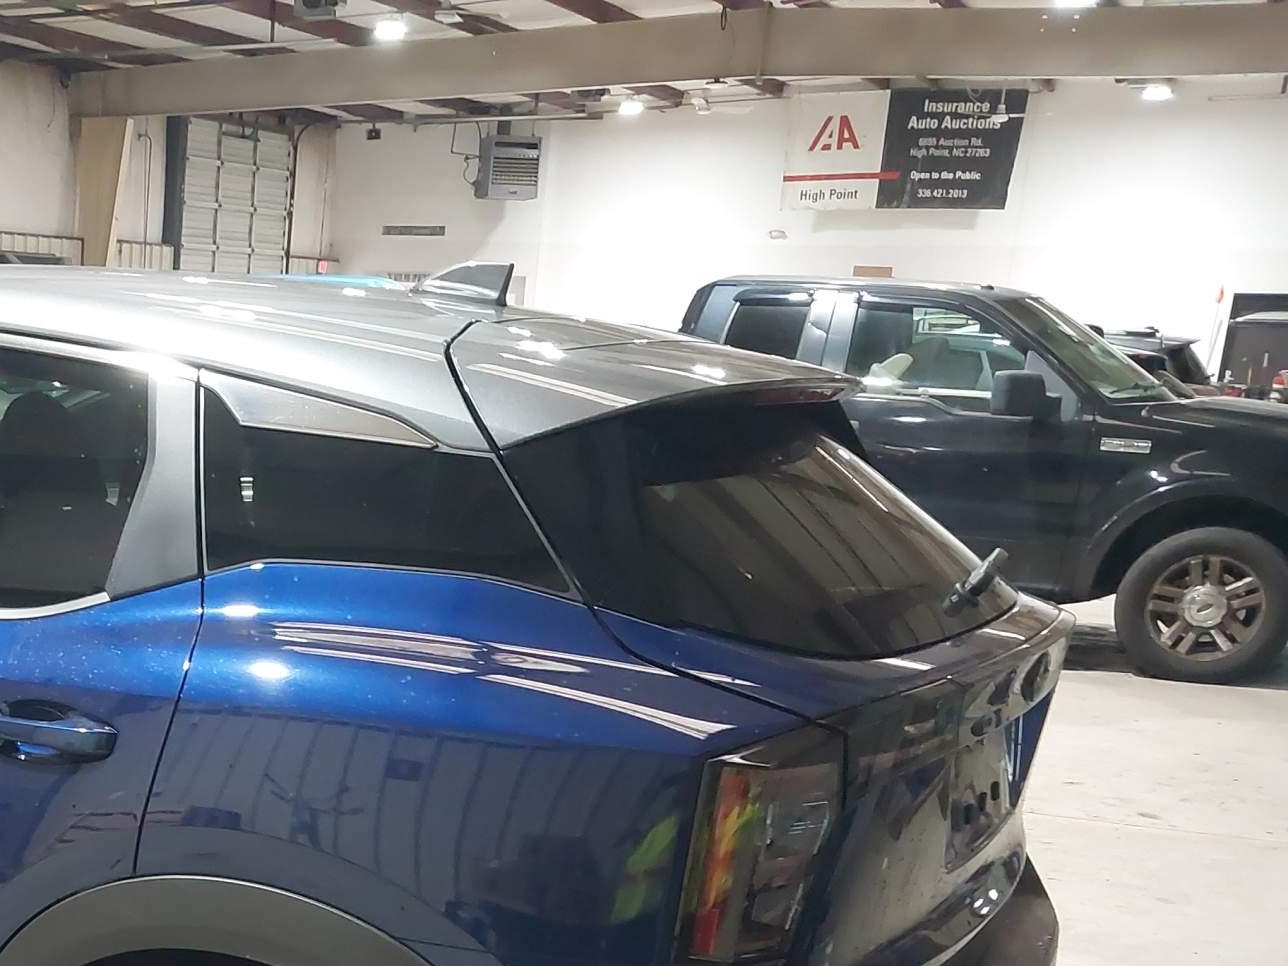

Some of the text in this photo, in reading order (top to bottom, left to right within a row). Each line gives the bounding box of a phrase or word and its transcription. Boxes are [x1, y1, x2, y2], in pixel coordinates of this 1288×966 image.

[924, 99, 990, 113] Insurance
[907, 115, 1001, 129] Auto Auctions
[952, 147, 966, 157] NC
[910, 170, 981, 181] Open to the Public
[800, 188, 859, 203] High Point
